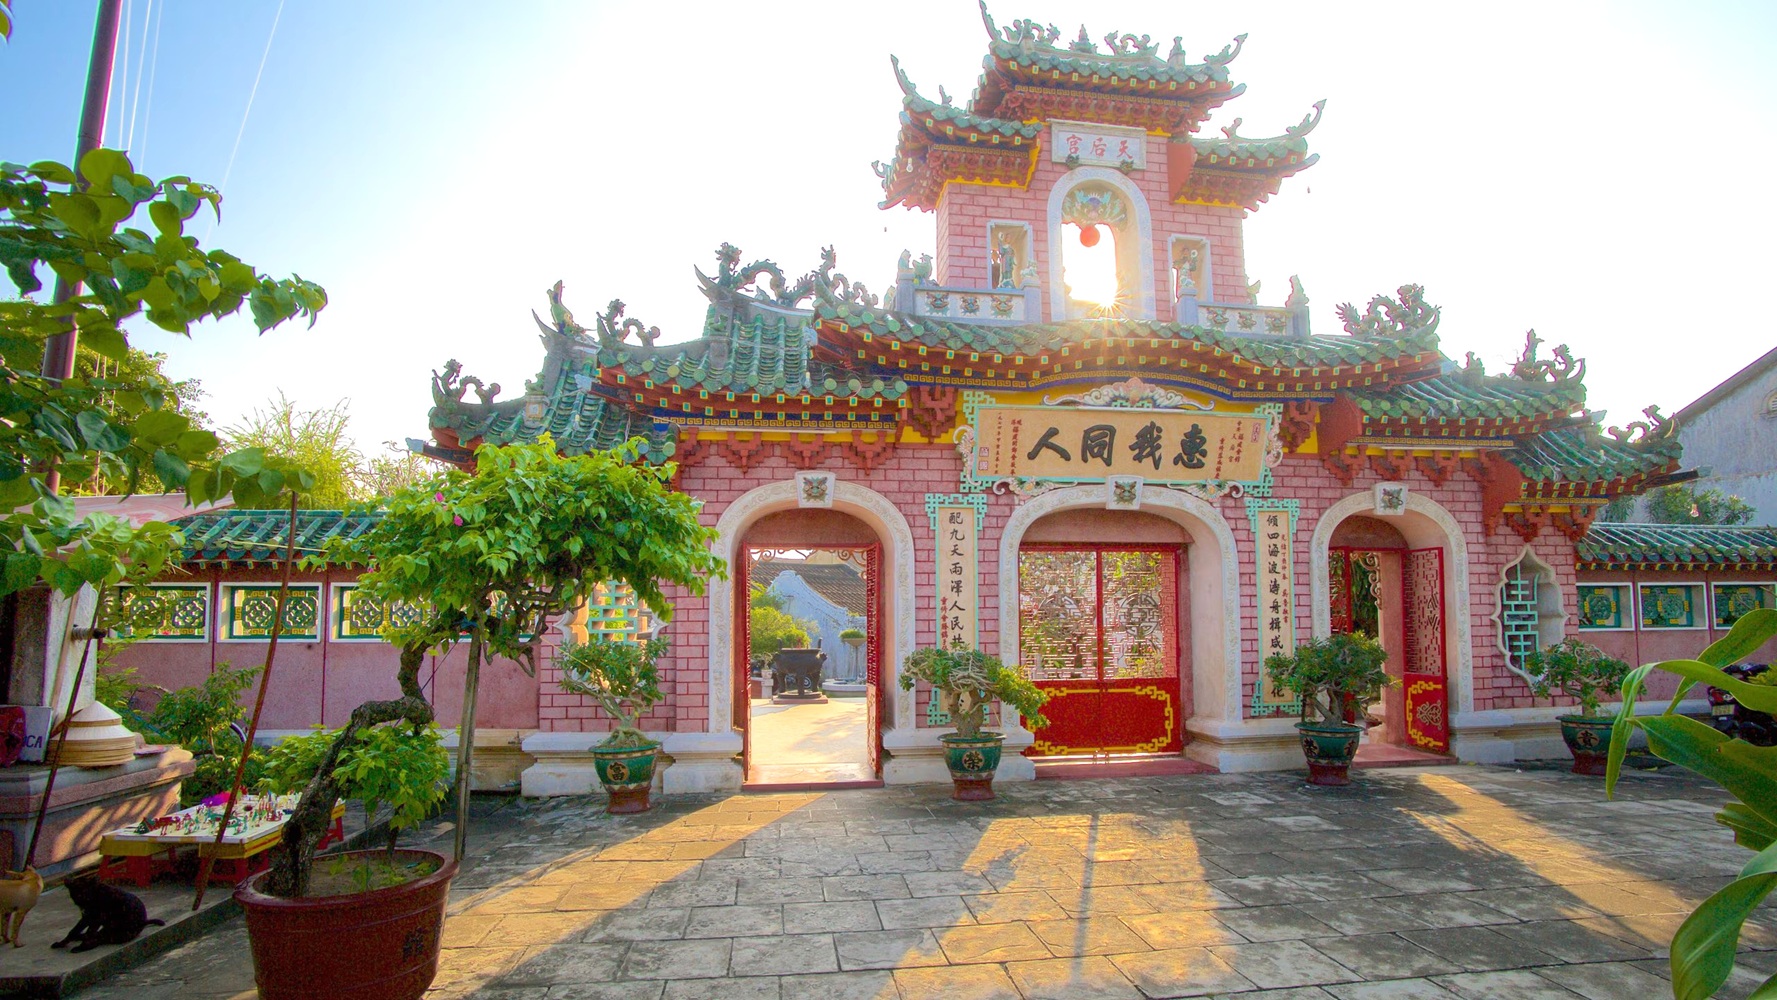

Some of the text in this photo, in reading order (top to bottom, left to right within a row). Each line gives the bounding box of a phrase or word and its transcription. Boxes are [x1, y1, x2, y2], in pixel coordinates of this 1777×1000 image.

[1027, 421, 1207, 470] 惠我同人
[948, 511, 966, 712] 配九天雨澤人民共
[1266, 514, 1285, 698] 傾四海波濤舟楫咸化
